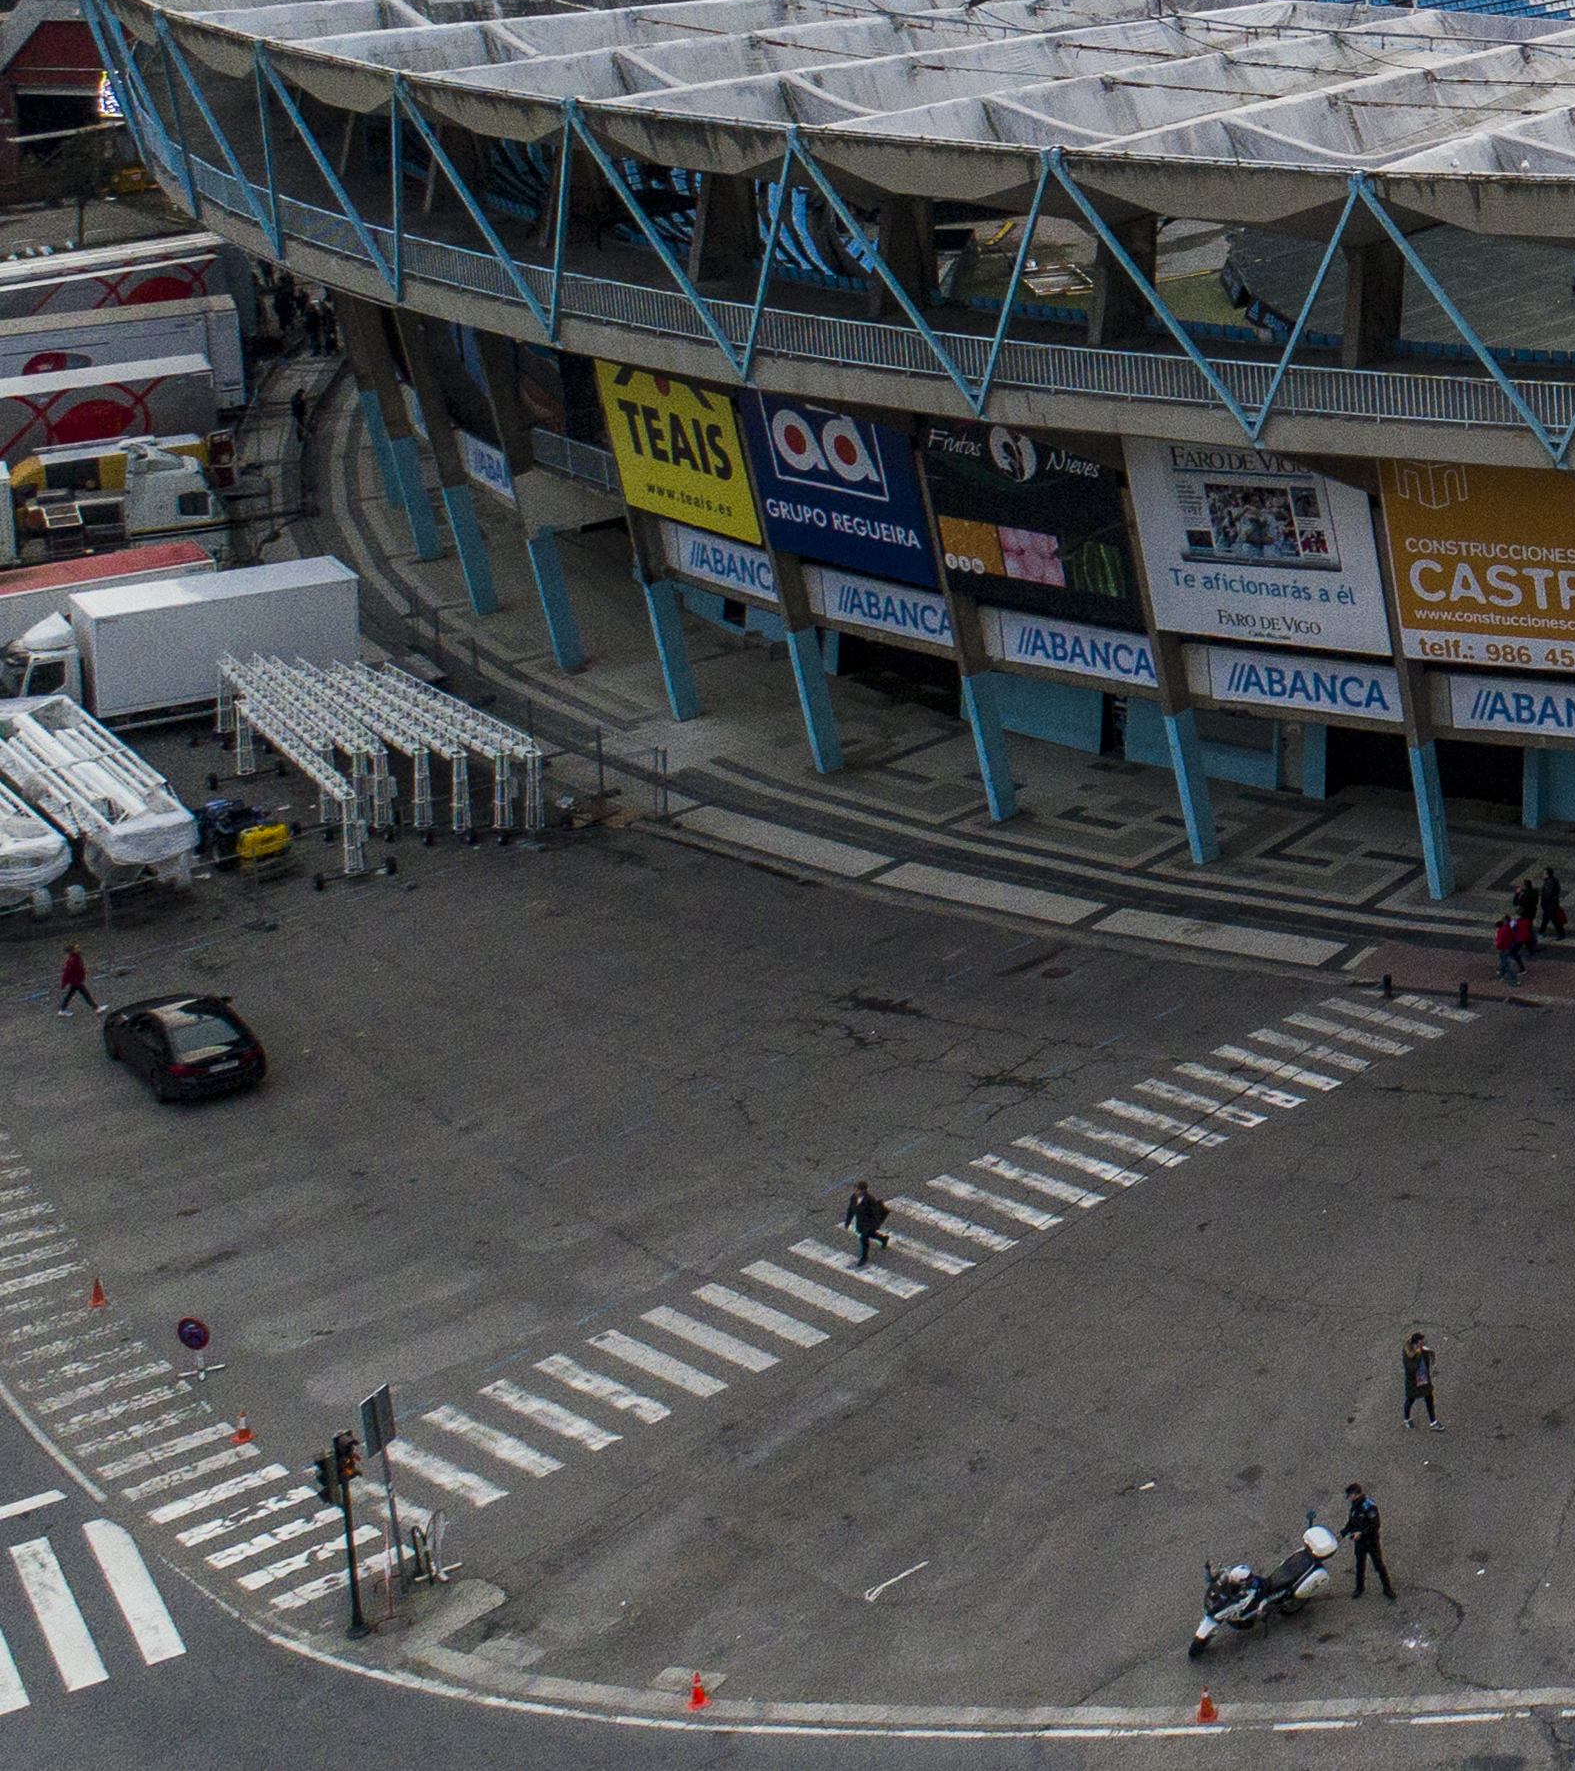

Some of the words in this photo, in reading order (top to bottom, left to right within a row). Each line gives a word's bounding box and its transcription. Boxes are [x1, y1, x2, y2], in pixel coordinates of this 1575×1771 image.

[618, 398, 734, 482] TEAIS
[926, 428, 983, 458] Frutas
[1045, 449, 1101, 479] Nieves
[1170, 445, 1227, 470] FARO
[1227, 455, 1253, 471] DE
[766, 497, 828, 529] GRUPO
[831, 512, 922, 550] REGUEIRA
[1169, 567, 1196, 590] Te
[1203, 572, 1313, 603] aficionarás
[1319, 589, 1331, 603] a
[1338, 584, 1357, 606] él
[1216, 609, 1257, 630] FARO
[1258, 615, 1280, 631] DE
[1280, 615, 1321, 636] VIGO
[1419, 636, 1475, 660] telf.:
[1486, 641, 1532, 666] 986
